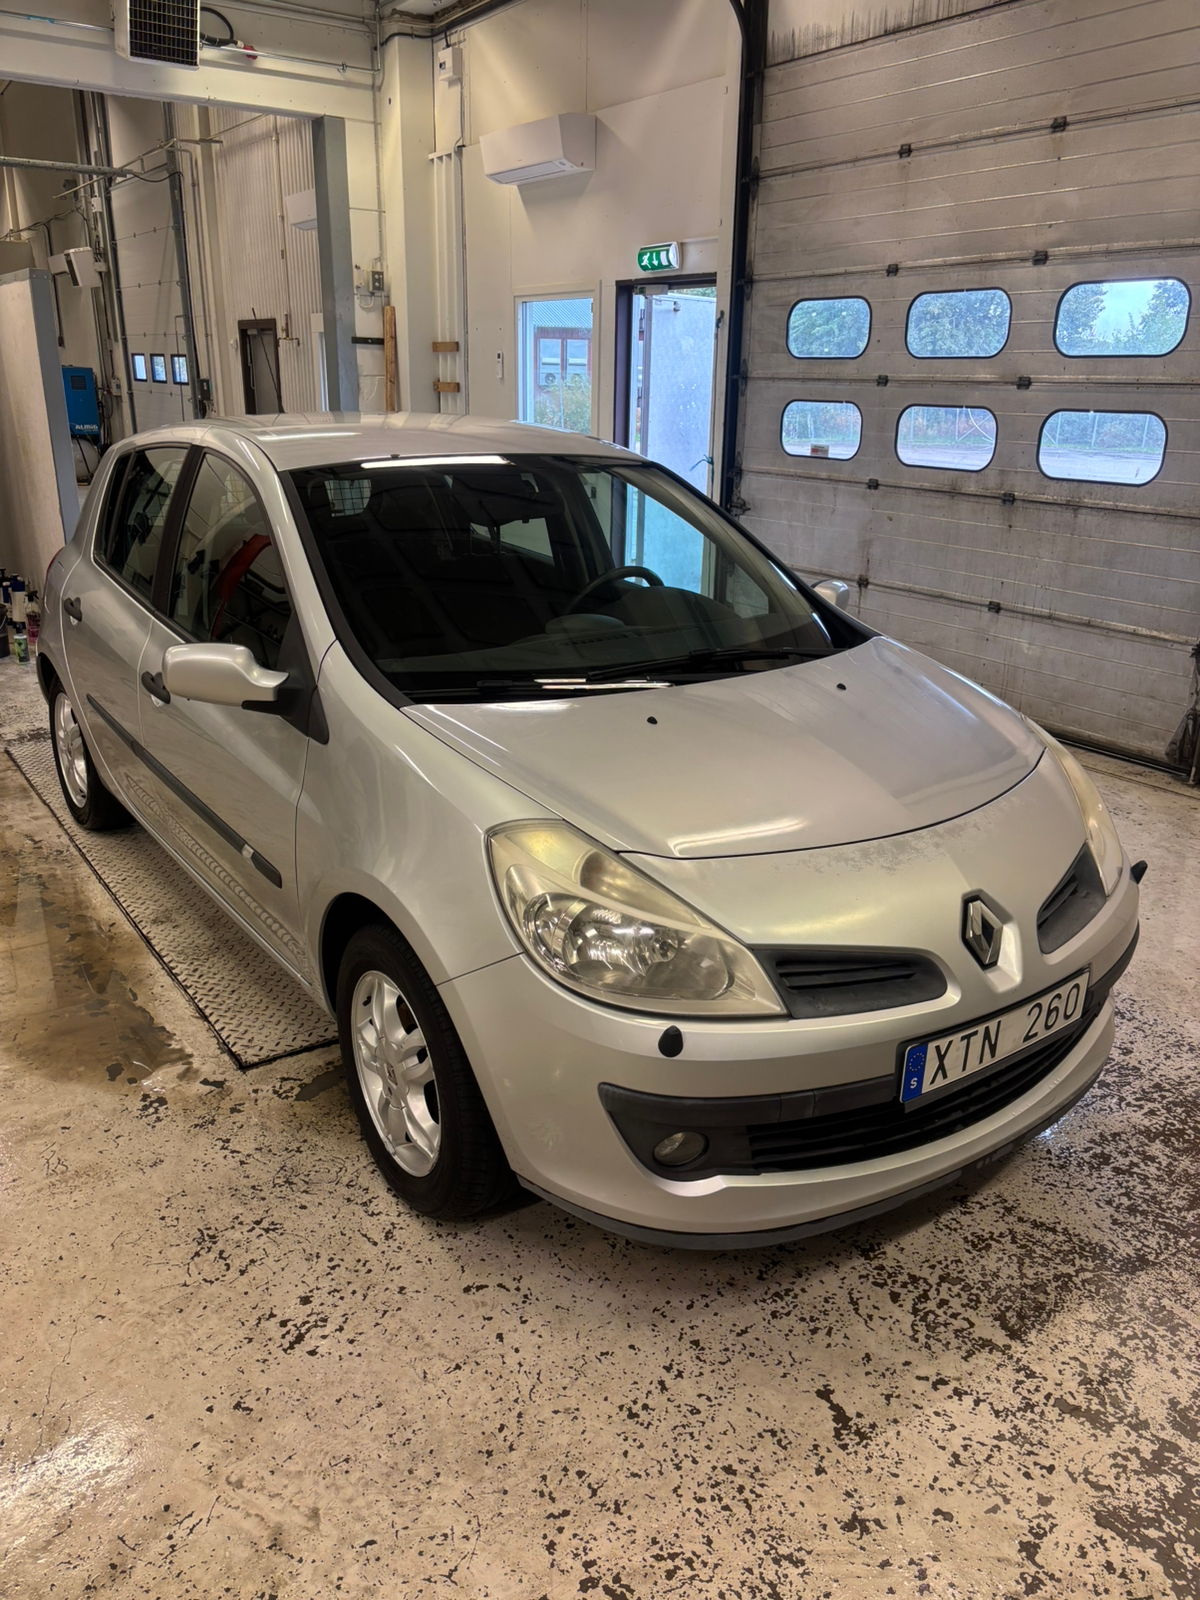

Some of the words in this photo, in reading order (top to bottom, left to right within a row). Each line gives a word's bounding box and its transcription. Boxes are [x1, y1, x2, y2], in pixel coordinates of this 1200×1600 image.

[929, 1020, 1002, 1085] XTN
[1022, 983, 1080, 1043] 260
[909, 1077, 918, 1089] S
